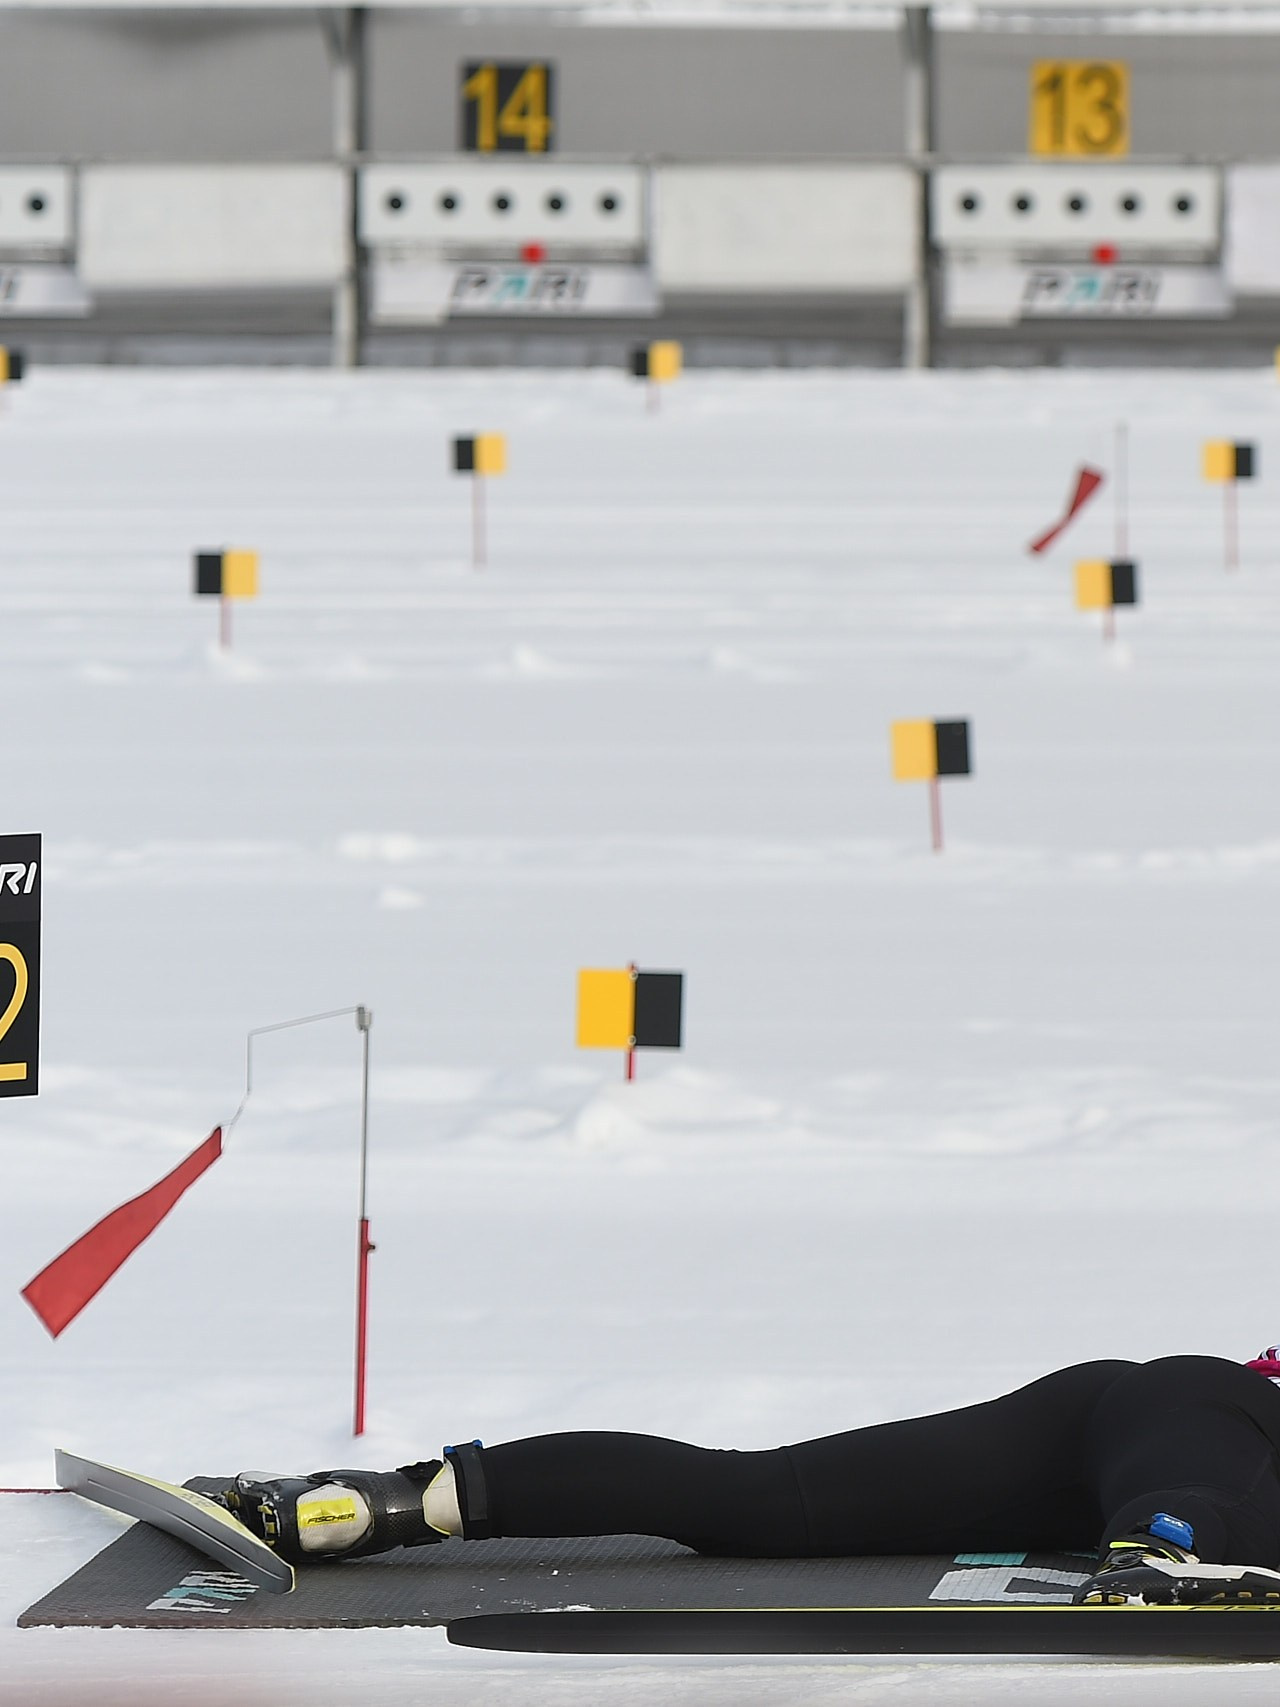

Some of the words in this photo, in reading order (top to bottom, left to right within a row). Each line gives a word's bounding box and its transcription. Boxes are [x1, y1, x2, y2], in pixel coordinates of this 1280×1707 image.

[463, 62, 554, 154] 14
[1034, 64, 1124, 155] 13
[307, 1512, 356, 1524] FISCHER
